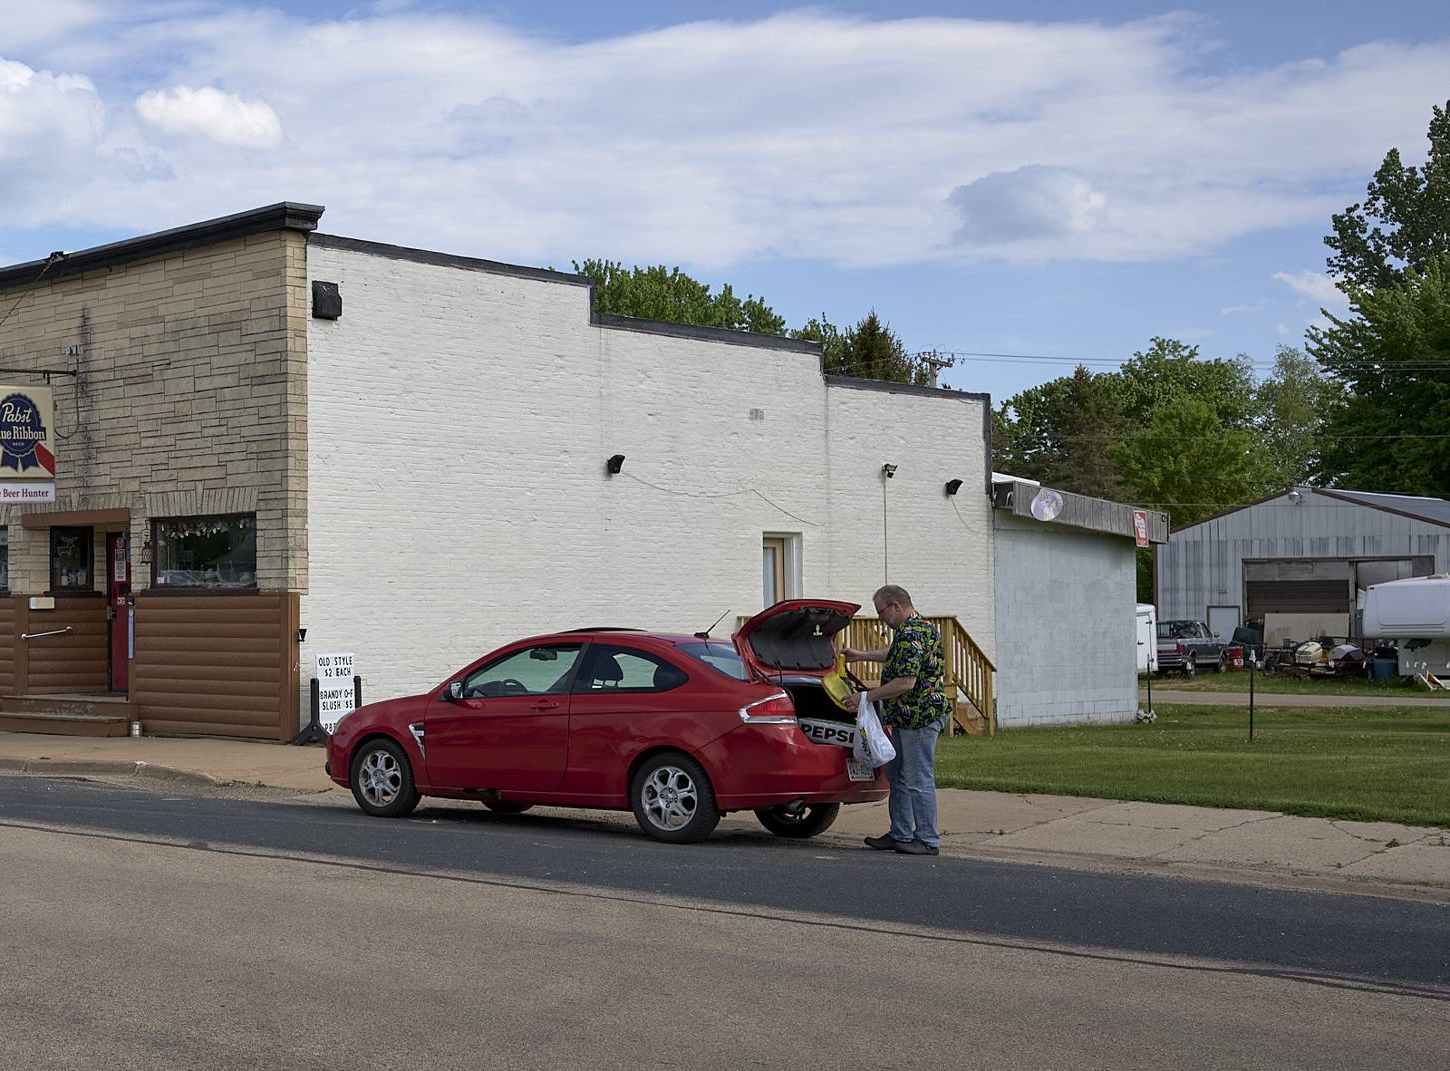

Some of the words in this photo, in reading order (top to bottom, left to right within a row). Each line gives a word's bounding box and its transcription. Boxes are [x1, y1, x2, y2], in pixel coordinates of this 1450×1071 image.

[1, 402, 32, 423] Pabst
[12, 426, 46, 440] Ribbon
[2, 488, 20, 498] Beer
[21, 488, 49, 498] Hunter
[318, 657, 330, 666] OLD
[334, 656, 352, 666] STYLE
[325, 668, 332, 677] $2
[336, 667, 351, 676] EACH
[320, 690, 342, 700] BRANDY
[322, 701, 341, 711] SLUSH
[345, 699, 353, 709] $5
[800, 723, 855, 744] PEPSI
